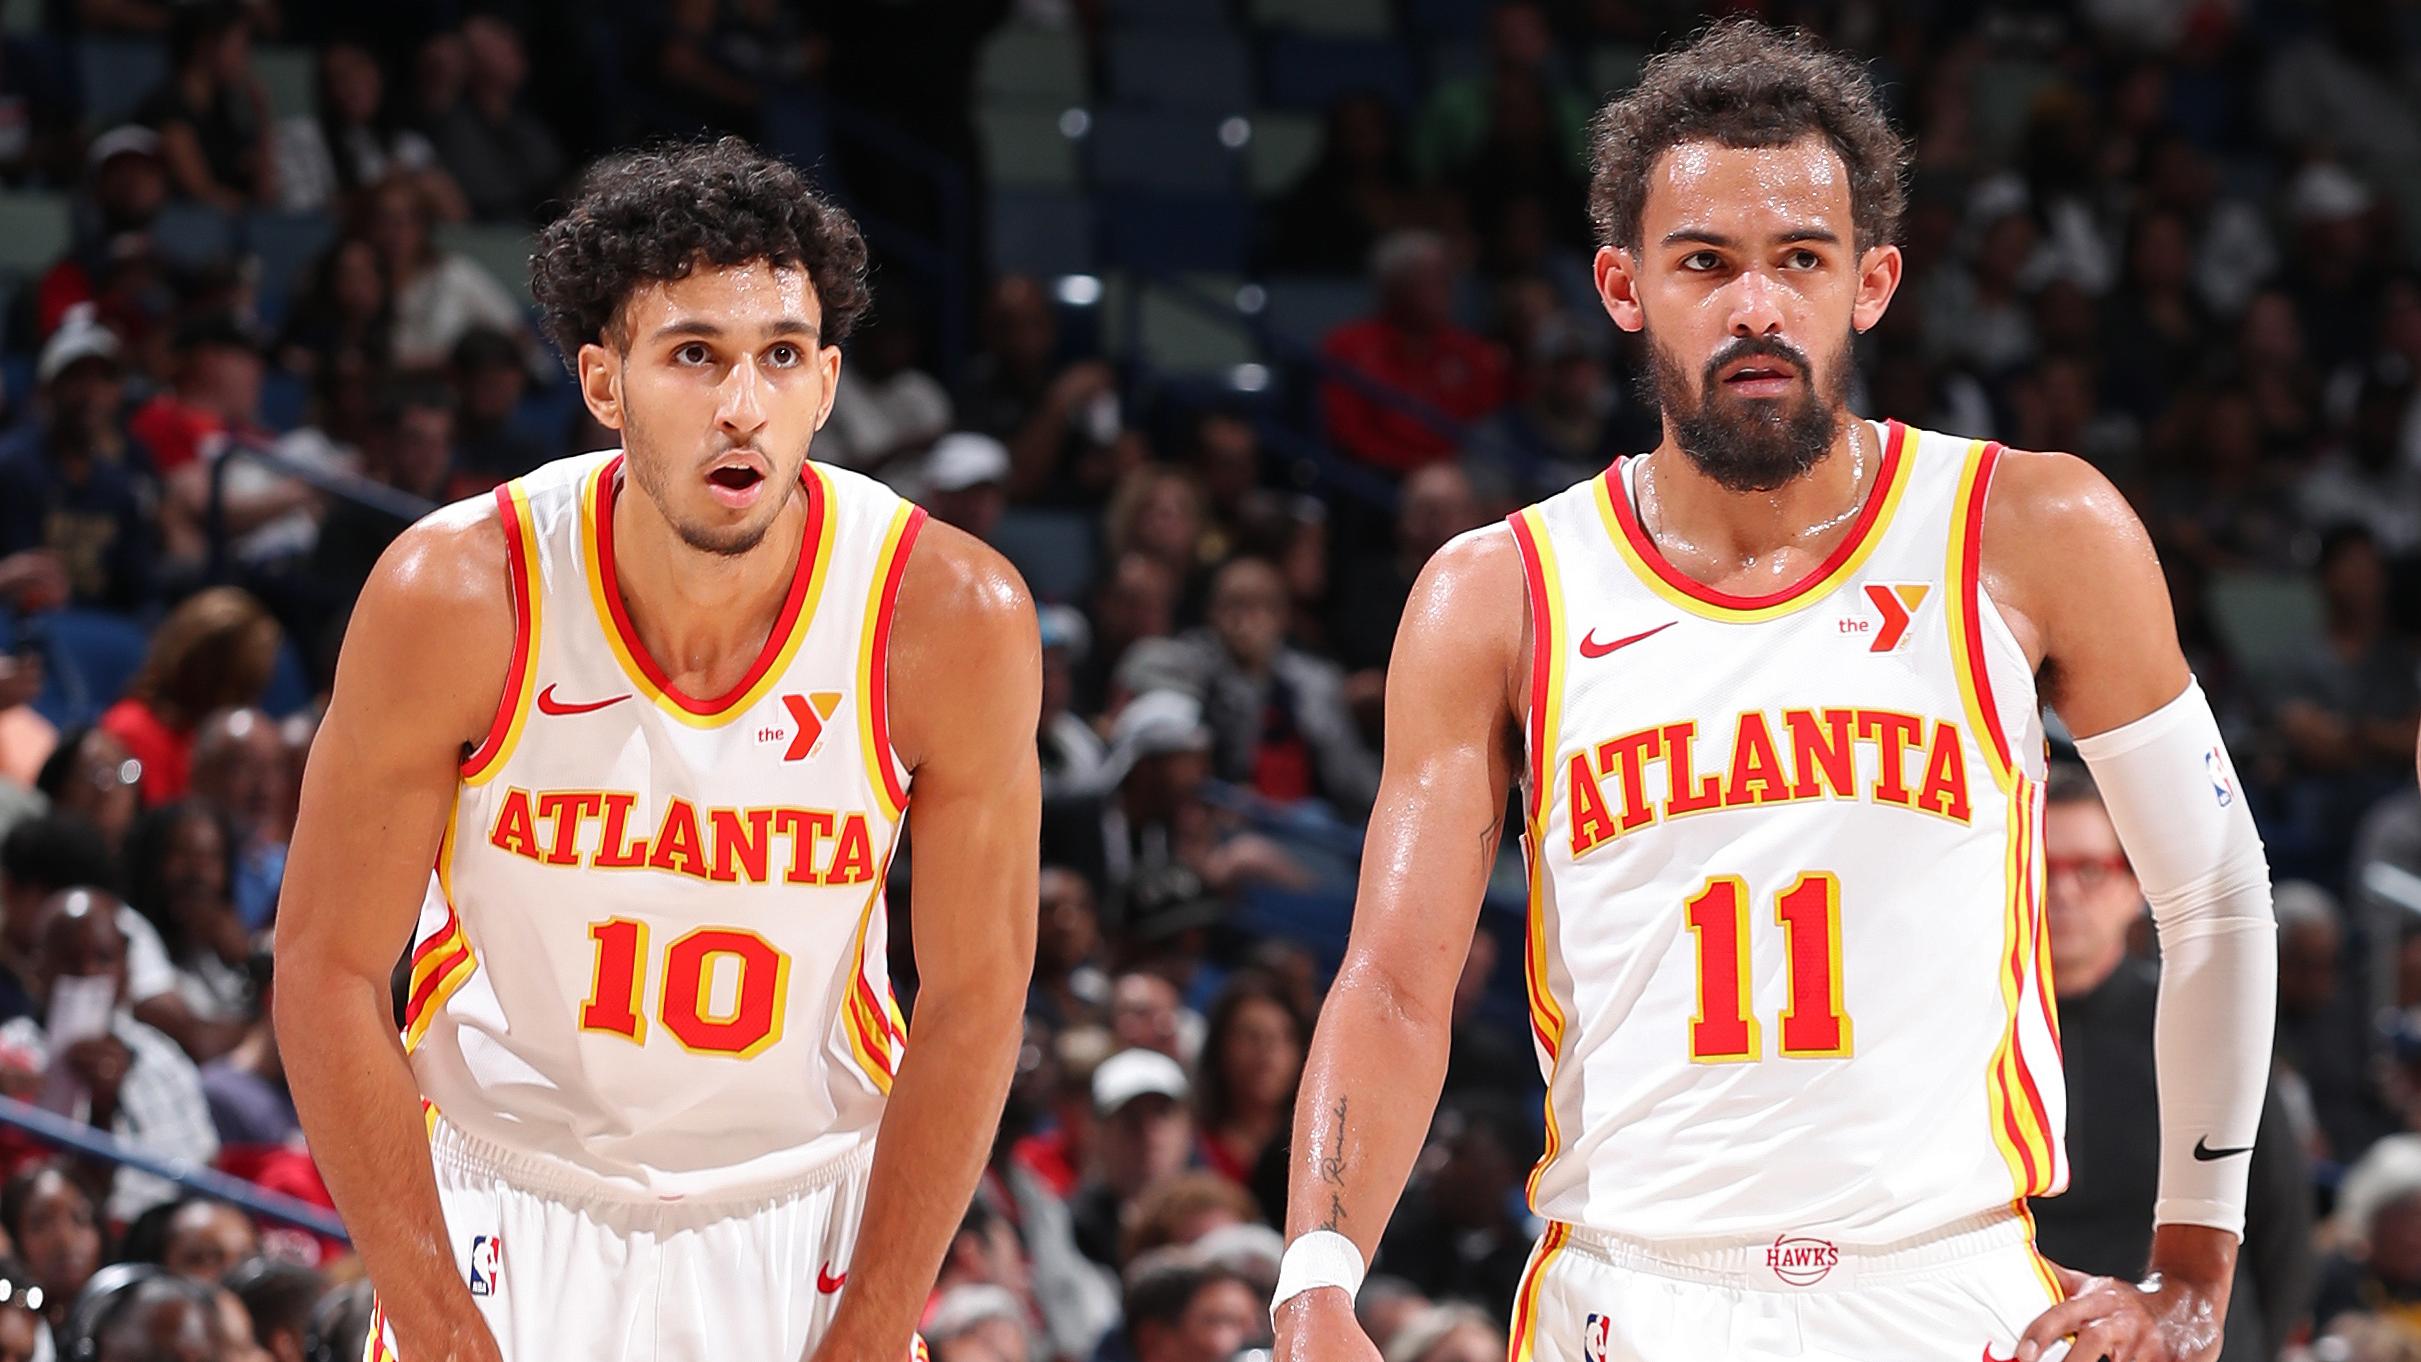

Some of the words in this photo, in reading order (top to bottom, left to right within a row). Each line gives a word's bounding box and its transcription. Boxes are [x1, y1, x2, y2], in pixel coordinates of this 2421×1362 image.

[1838, 618, 1869, 633] the
[758, 726, 784, 742] the
[1567, 706, 1972, 860] ATLANTA
[489, 786, 877, 887] ATLANTA
[578, 915, 792, 1060] 10
[1684, 870, 1853, 1064] 11
[1766, 1247, 1839, 1266] HAWKS
